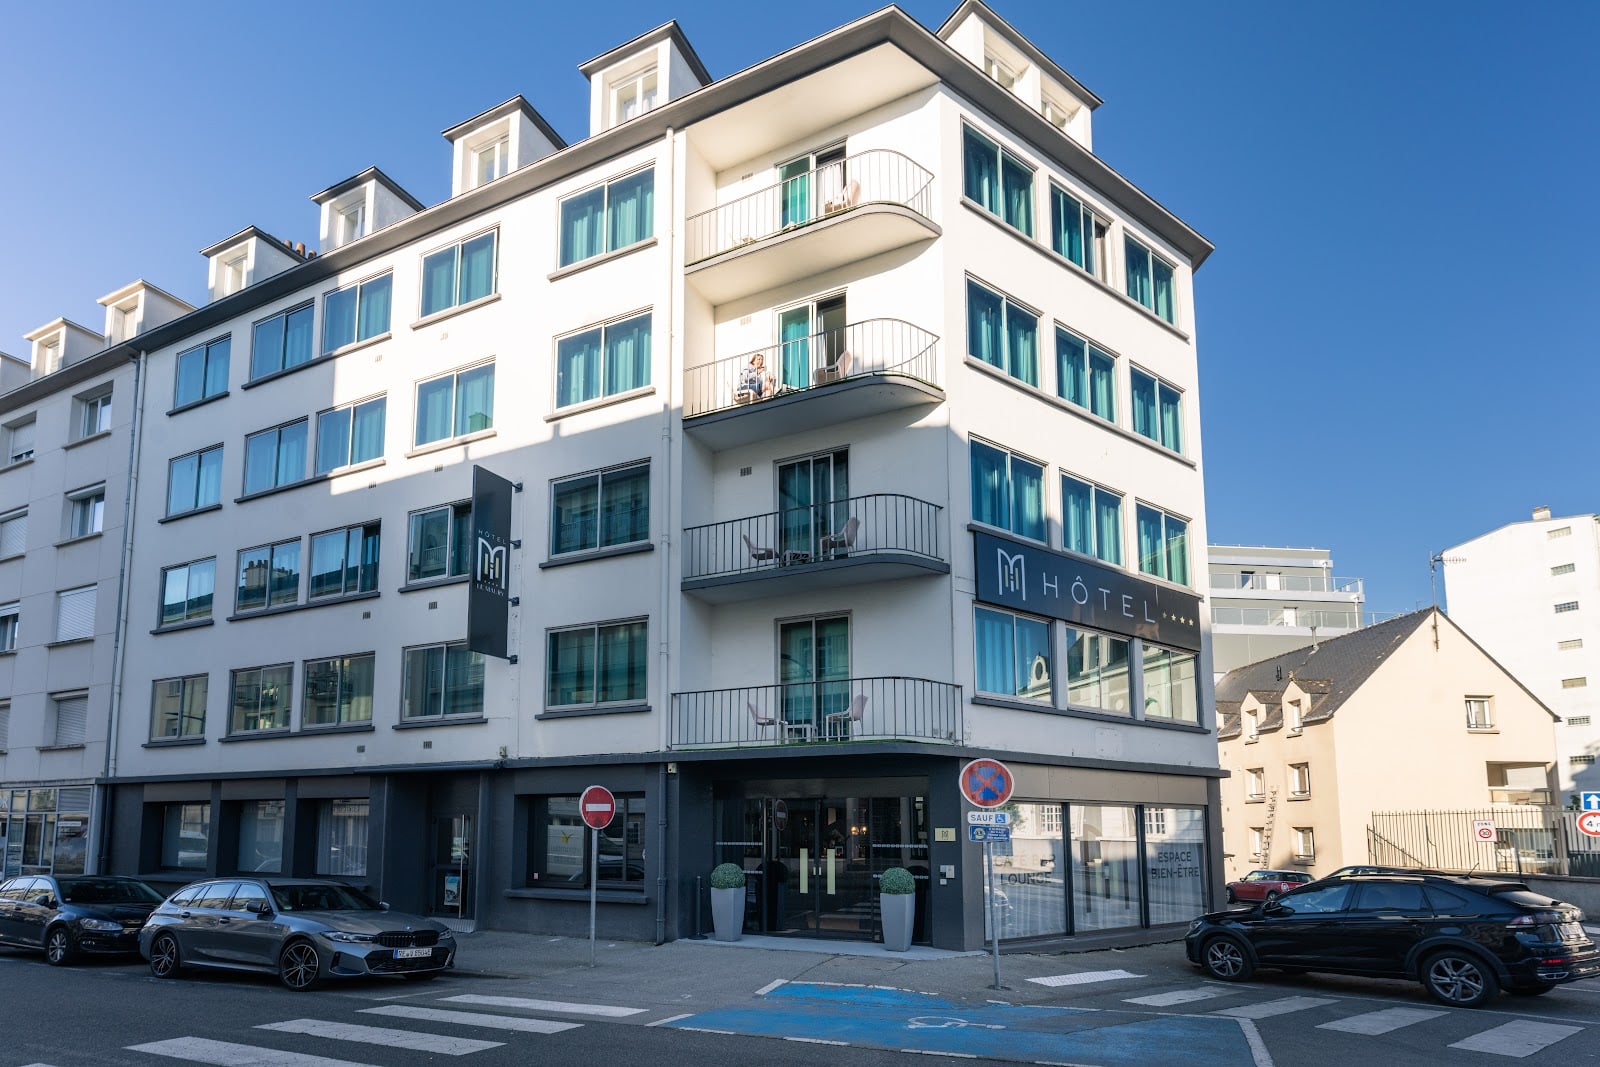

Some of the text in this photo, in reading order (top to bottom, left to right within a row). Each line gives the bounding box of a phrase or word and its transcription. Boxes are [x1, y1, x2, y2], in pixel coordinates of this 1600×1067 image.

[1042, 572, 1156, 624] HÔTEL
[970, 814, 993, 822] SAUF
[1157, 851, 1192, 863] ESPACE
[1000, 871, 1052, 886] LOUNGE
[1151, 863, 1200, 880] BIEN-ÊTRE
